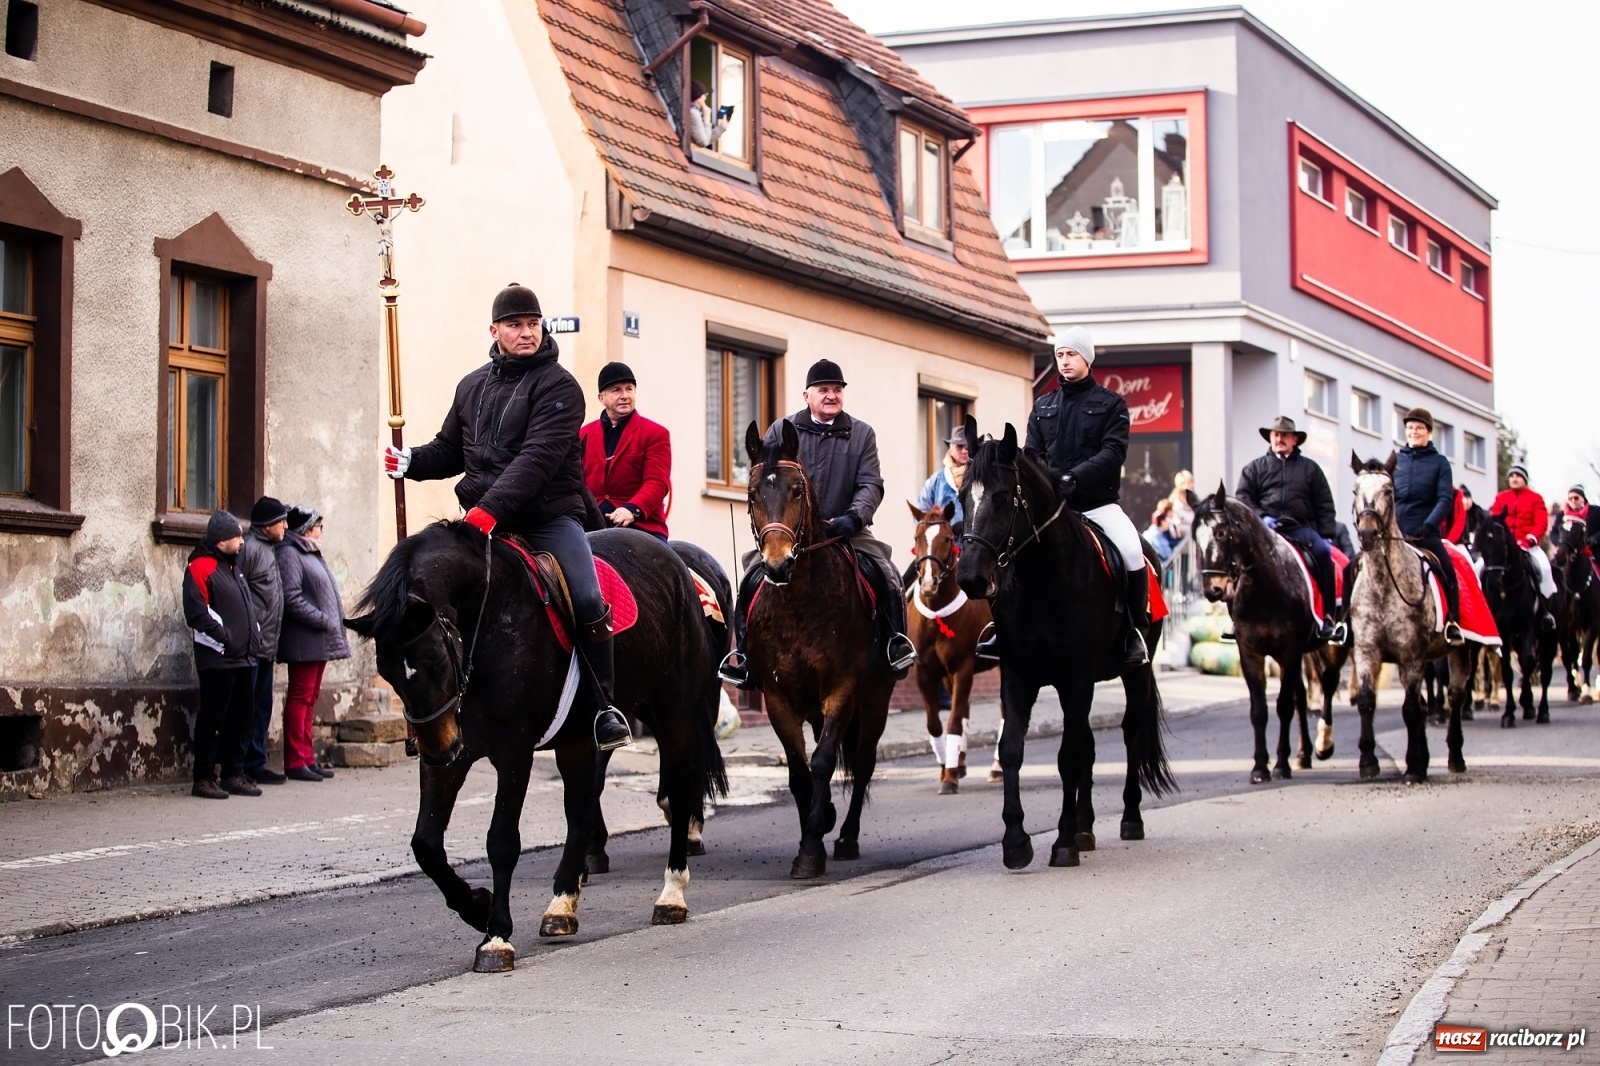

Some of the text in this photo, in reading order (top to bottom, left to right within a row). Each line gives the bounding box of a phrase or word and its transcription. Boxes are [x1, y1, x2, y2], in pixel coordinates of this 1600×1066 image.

[545, 317, 575, 333] Tylna
[1103, 374, 1152, 395] Dom
[1129, 392, 1173, 426] gród
